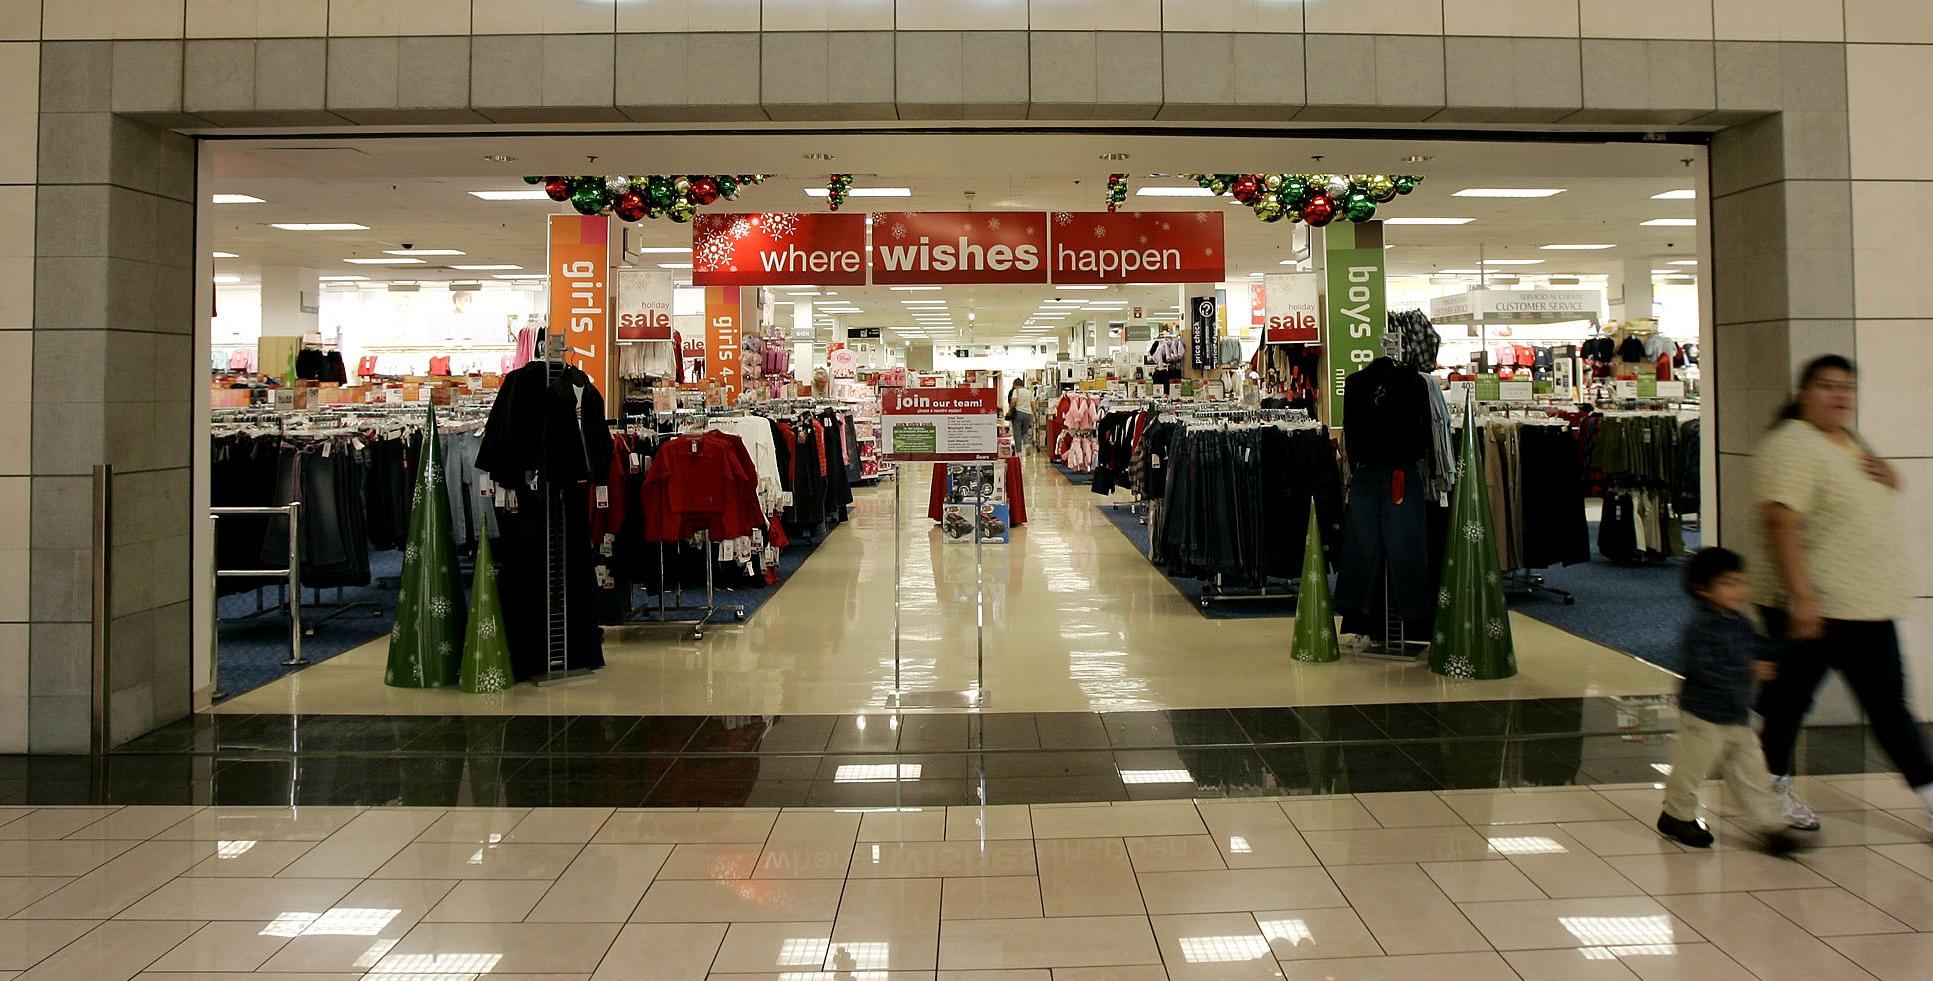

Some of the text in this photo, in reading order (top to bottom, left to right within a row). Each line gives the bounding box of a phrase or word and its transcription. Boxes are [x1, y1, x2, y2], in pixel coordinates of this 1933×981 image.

[759, 236, 1181, 278] where wishes happen
[562, 261, 602, 333] girls
[641, 301, 670, 310] holiday
[1340, 266, 1378, 339] boys
[1288, 303, 1316, 312] holiday
[1495, 302, 1583, 311] CUSTOMER SERVICE
[620, 309, 670, 328] sale
[1269, 311, 1316, 329] sale
[683, 339, 705, 351] ale
[713, 316, 738, 361] girls
[1193, 321, 1203, 364] price check
[895, 394, 983, 410] join our team!
